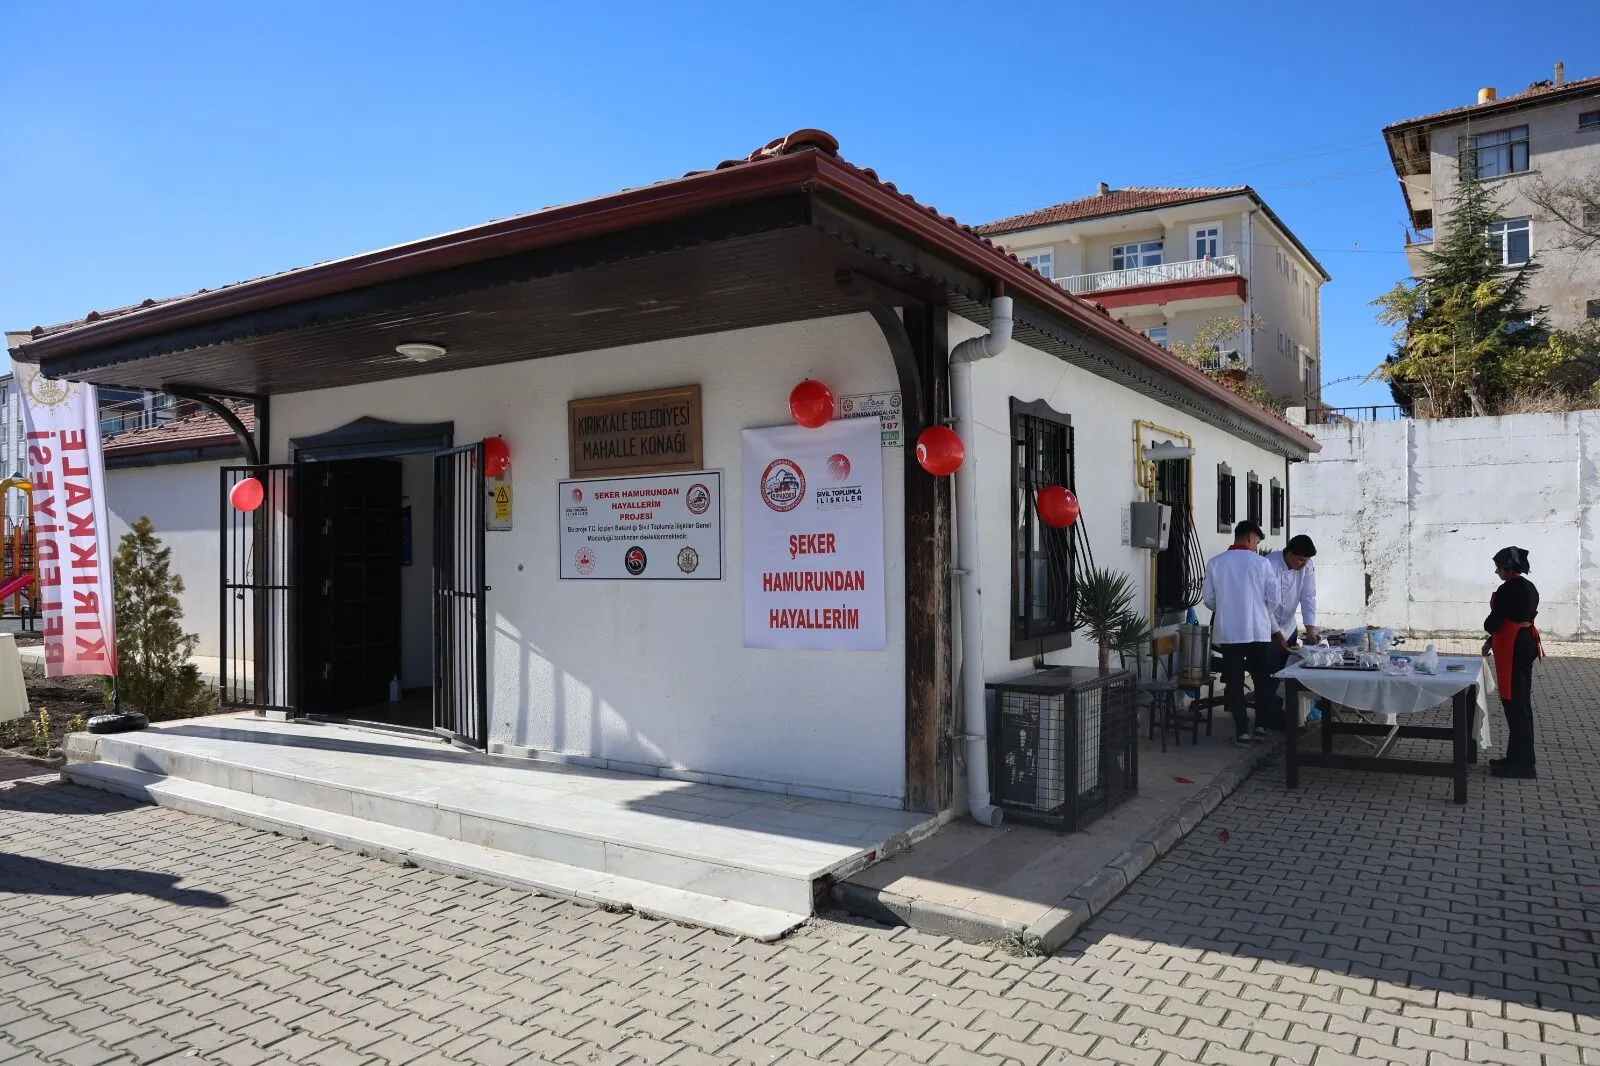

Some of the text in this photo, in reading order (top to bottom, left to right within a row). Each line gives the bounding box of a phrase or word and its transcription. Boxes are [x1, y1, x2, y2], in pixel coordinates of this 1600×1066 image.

[578, 401, 690, 435] KIRIKKALE BELEDİYESİ
[583, 430, 686, 460] MAHALLE KONAĞI
[594, 488, 680, 500] ŞEKER HAMURUNDAN
[831, 488, 862, 496] TOPLUMLA
[611, 499, 661, 510] HAYALLERİM
[619, 513, 653, 521] PROJESİ
[789, 533, 836, 560] ŞEKER
[763, 570, 865, 592] HAMURUNDAN
[769, 603, 859, 630] HAYALLERİM
